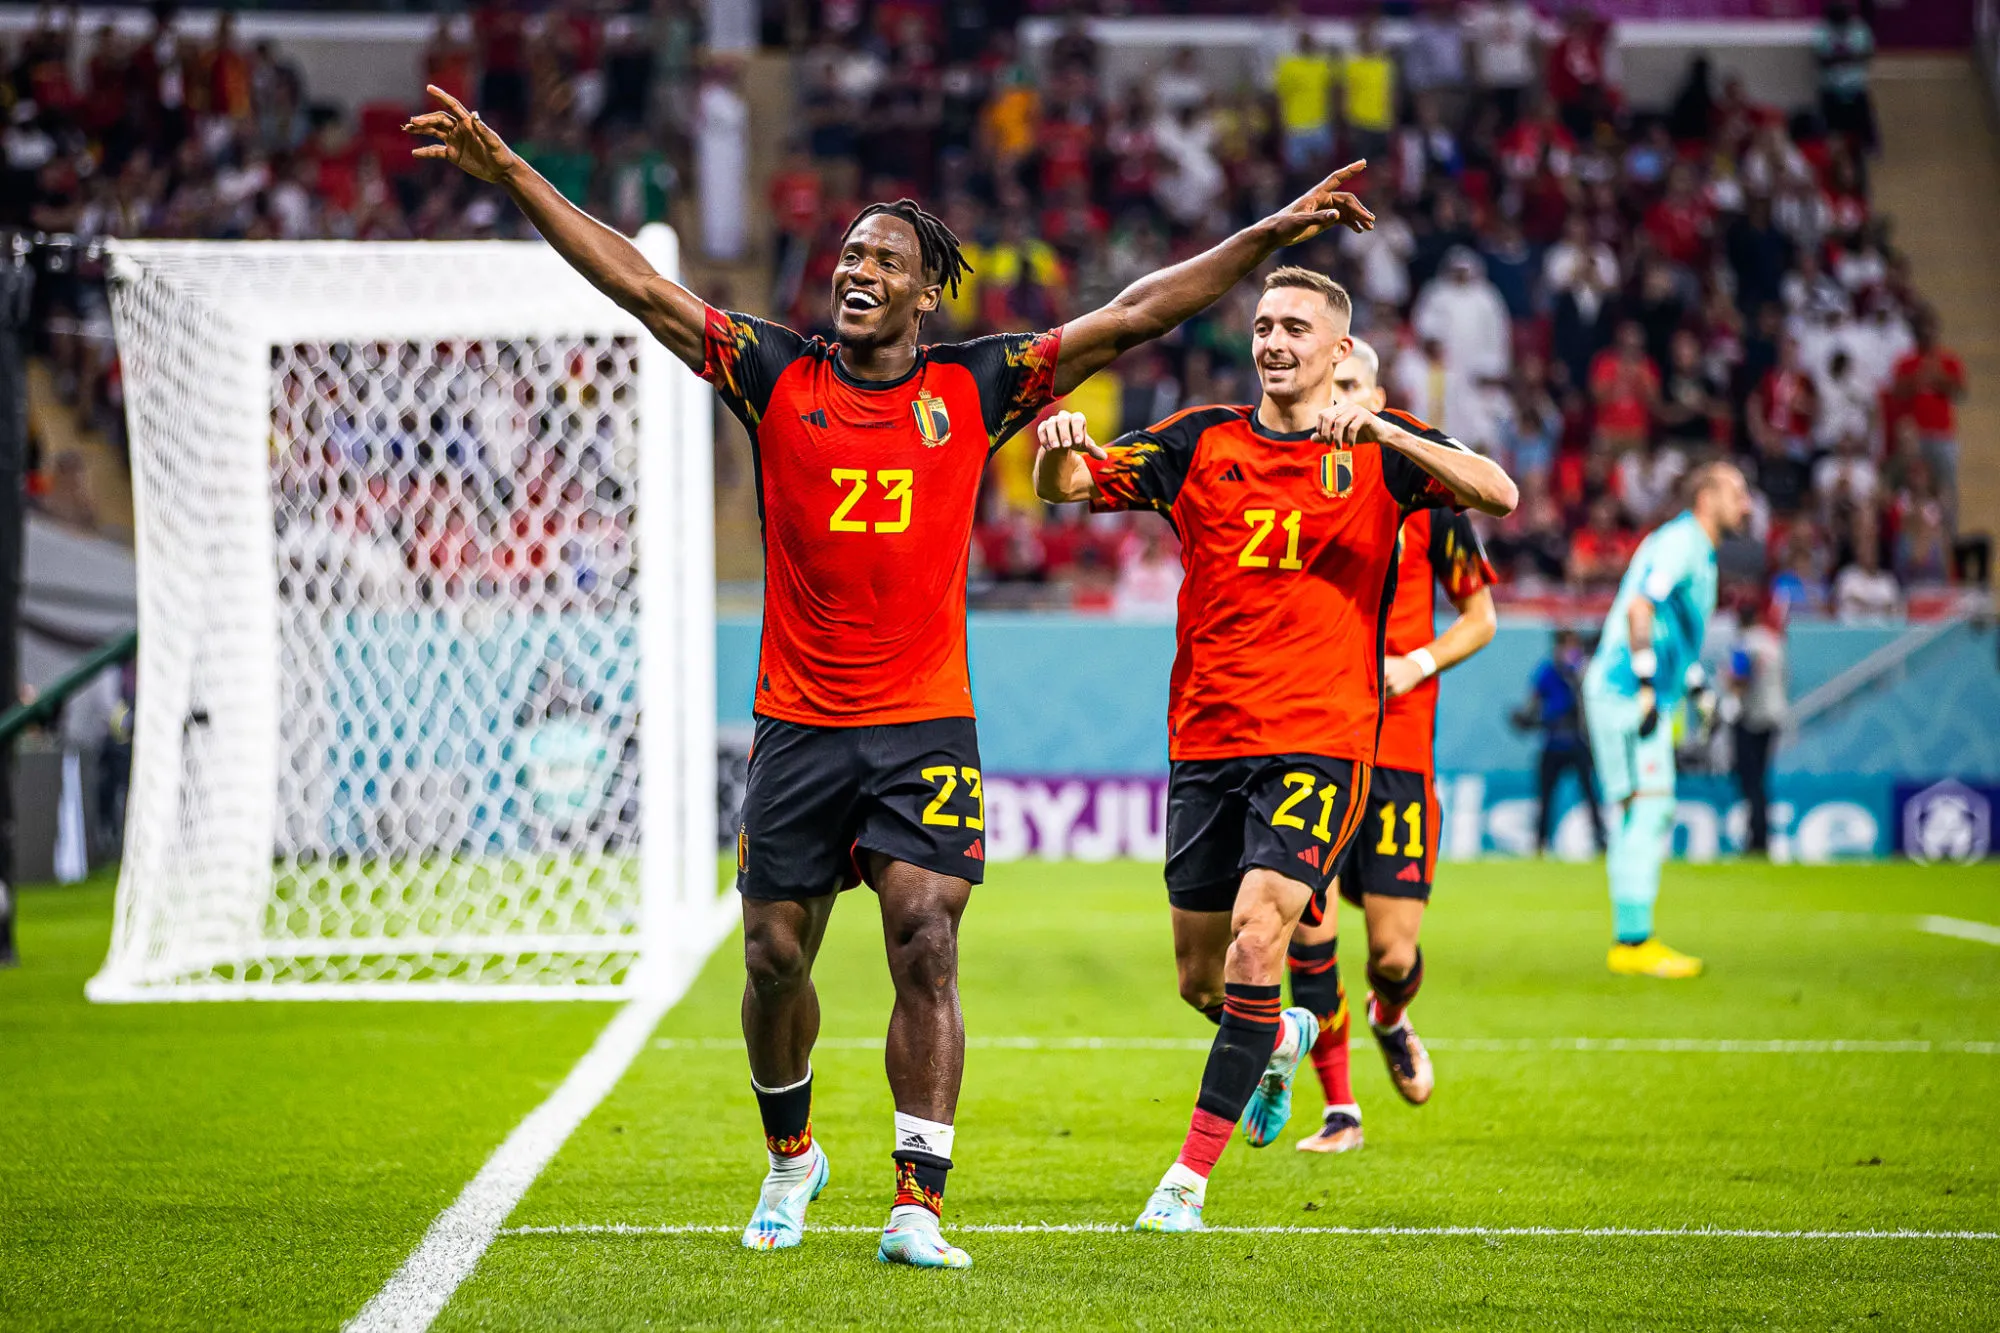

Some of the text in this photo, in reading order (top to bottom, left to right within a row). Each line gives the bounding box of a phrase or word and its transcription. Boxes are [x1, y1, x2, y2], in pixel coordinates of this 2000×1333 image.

[829, 468, 914, 533] 23
[1238, 509, 1303, 570] 21
[920, 765, 985, 832] 23
[1270, 771, 1338, 843] 21
[1374, 801, 1424, 858] 11
[902, 1141, 933, 1152] adidas
